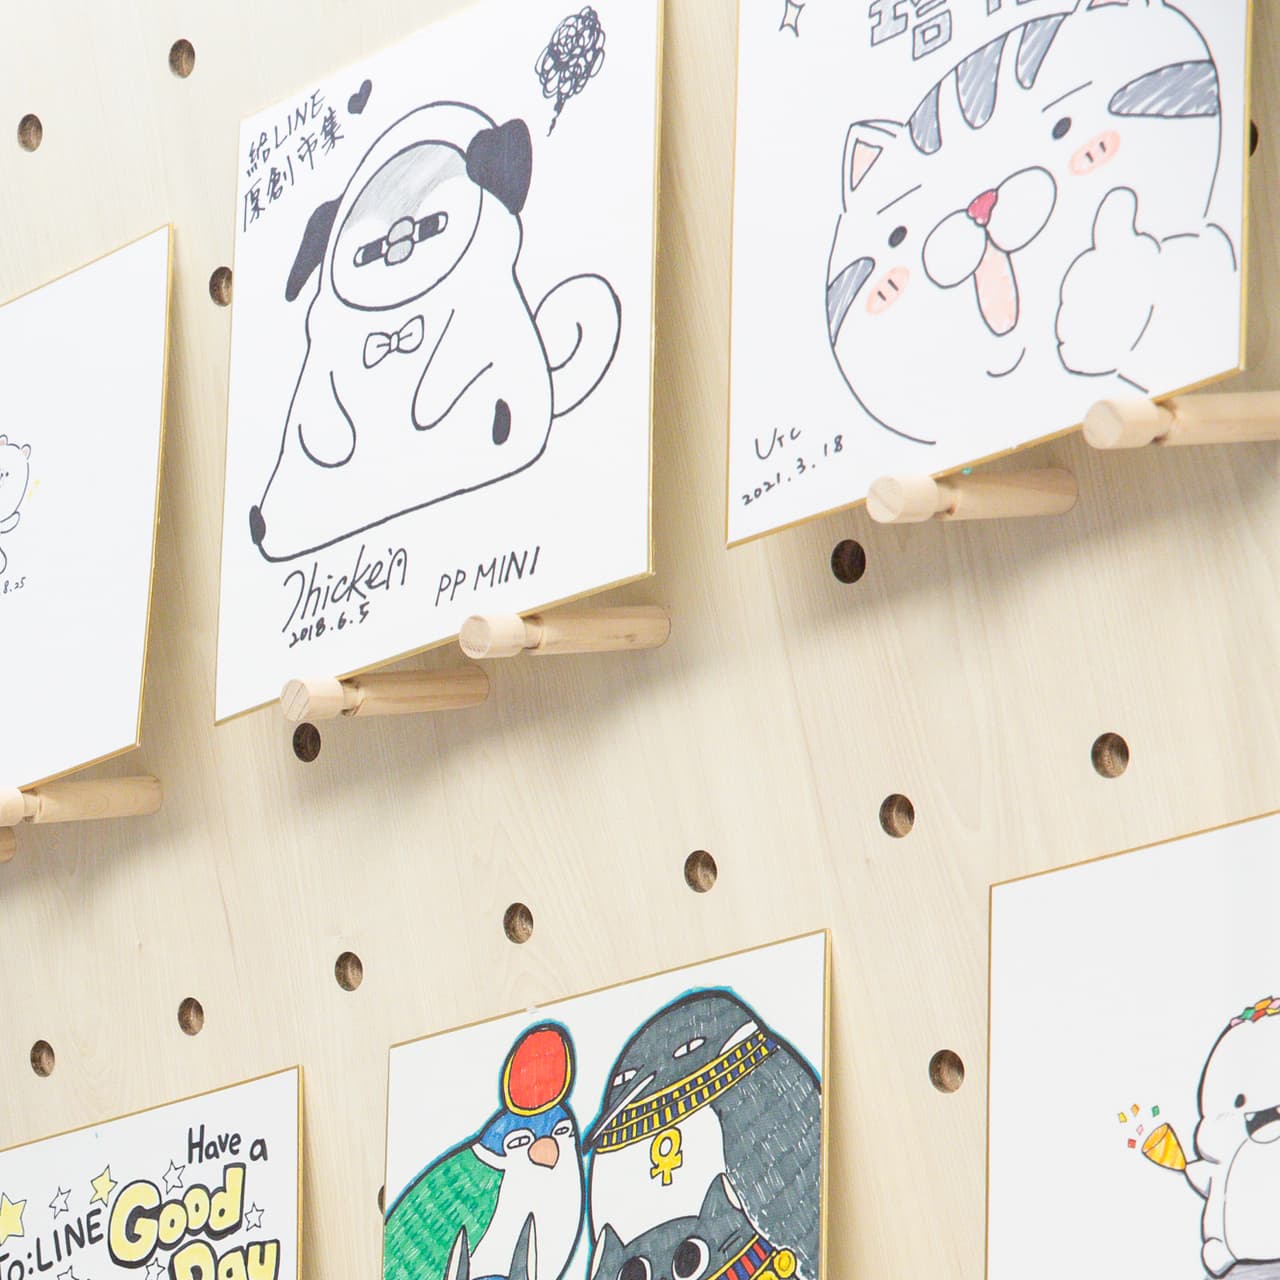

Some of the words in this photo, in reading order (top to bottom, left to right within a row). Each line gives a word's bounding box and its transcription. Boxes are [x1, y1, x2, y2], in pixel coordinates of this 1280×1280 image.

[473, 546, 541, 591] MINI
[188, 1124, 243, 1163] Have
[249, 1138, 269, 1162] a
[107, 1162, 247, 1269] Good
